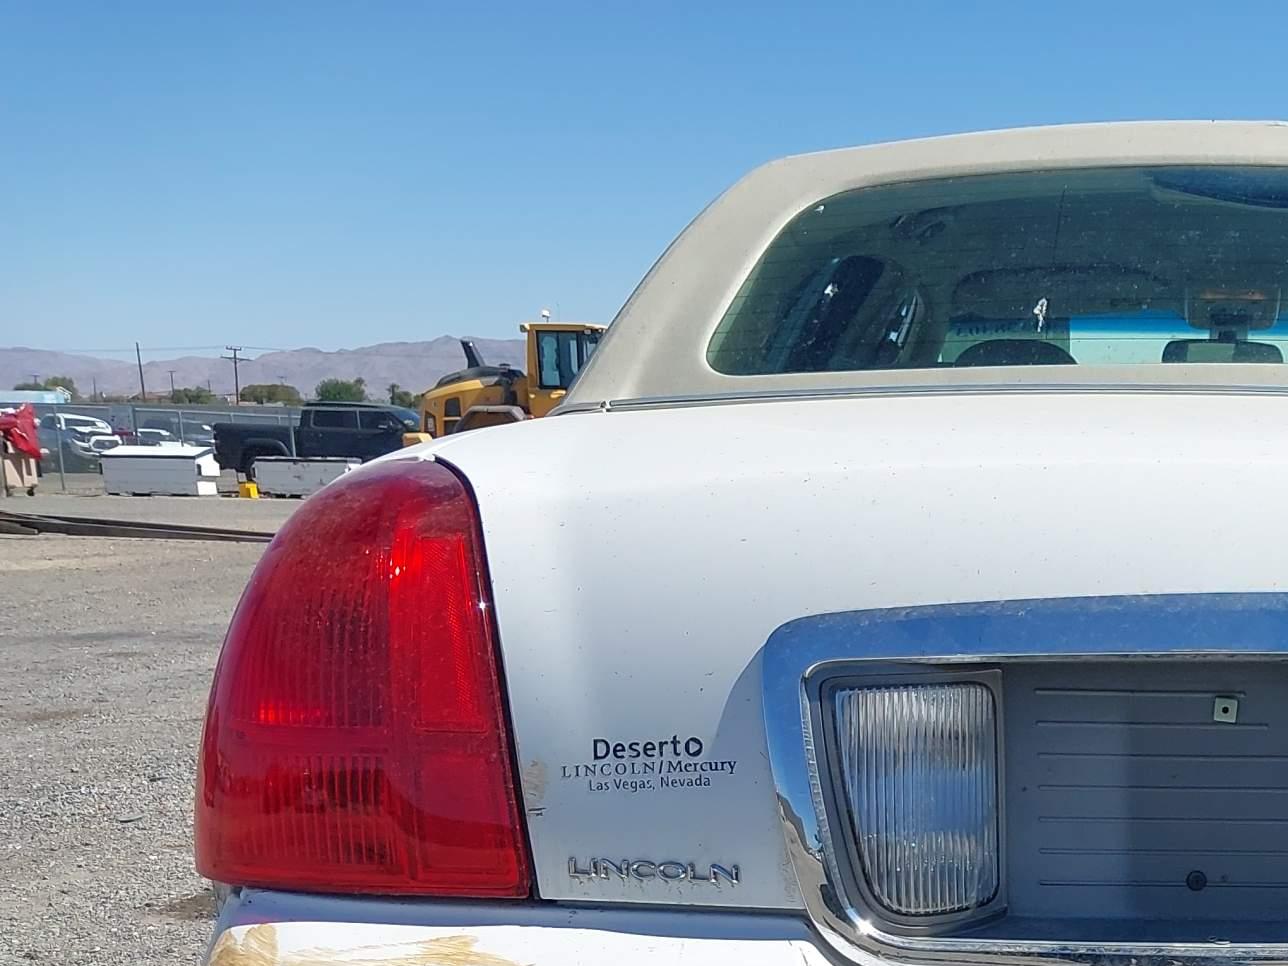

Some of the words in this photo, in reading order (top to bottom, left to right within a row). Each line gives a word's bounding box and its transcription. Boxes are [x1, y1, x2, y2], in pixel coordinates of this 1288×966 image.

[589, 779, 610, 792] Las
[613, 777, 656, 793] Vegas,
[660, 775, 711, 788] Nevada
[568, 856, 740, 884] LINCOLN
